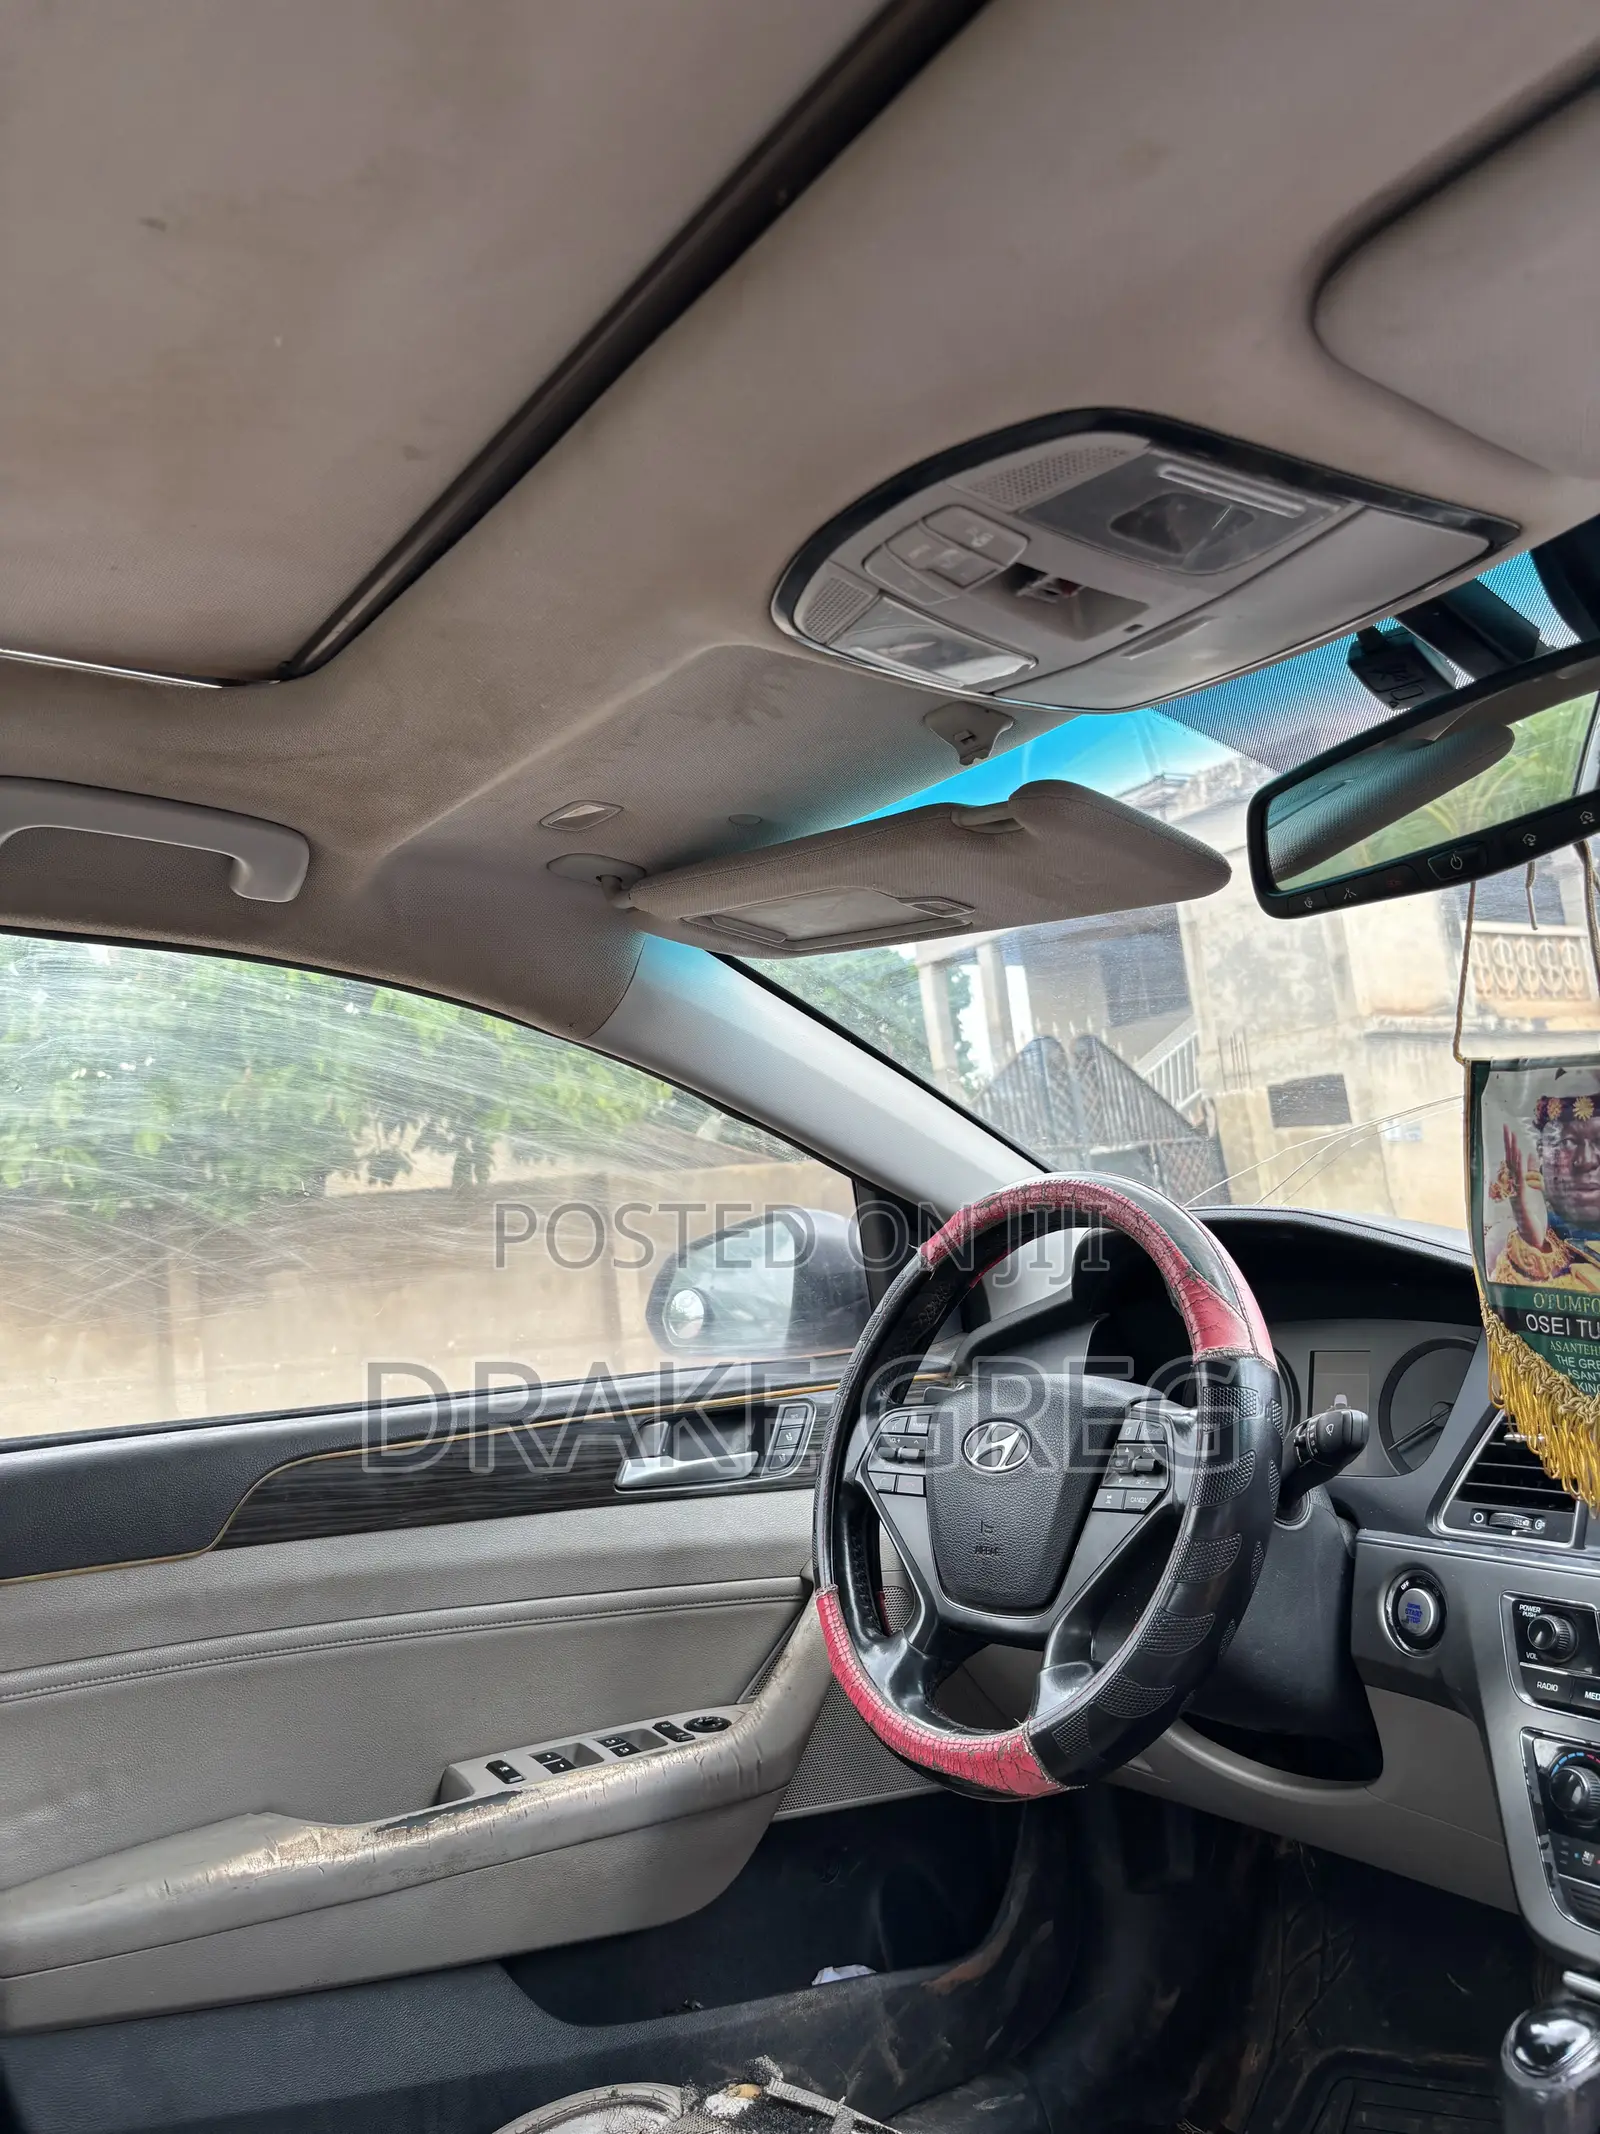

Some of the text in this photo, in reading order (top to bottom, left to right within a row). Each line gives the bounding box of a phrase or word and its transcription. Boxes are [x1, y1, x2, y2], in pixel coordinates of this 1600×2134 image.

[1525, 1313, 1570, 1336] OSEI
[1550, 1340, 1600, 1356] ASANTEH
[1554, 1353, 1576, 1368] THE
[1519, 1604, 1541, 1613] POWER
[1526, 1651, 1538, 1660] VOL
[1537, 1681, 1559, 1692] RADIO
